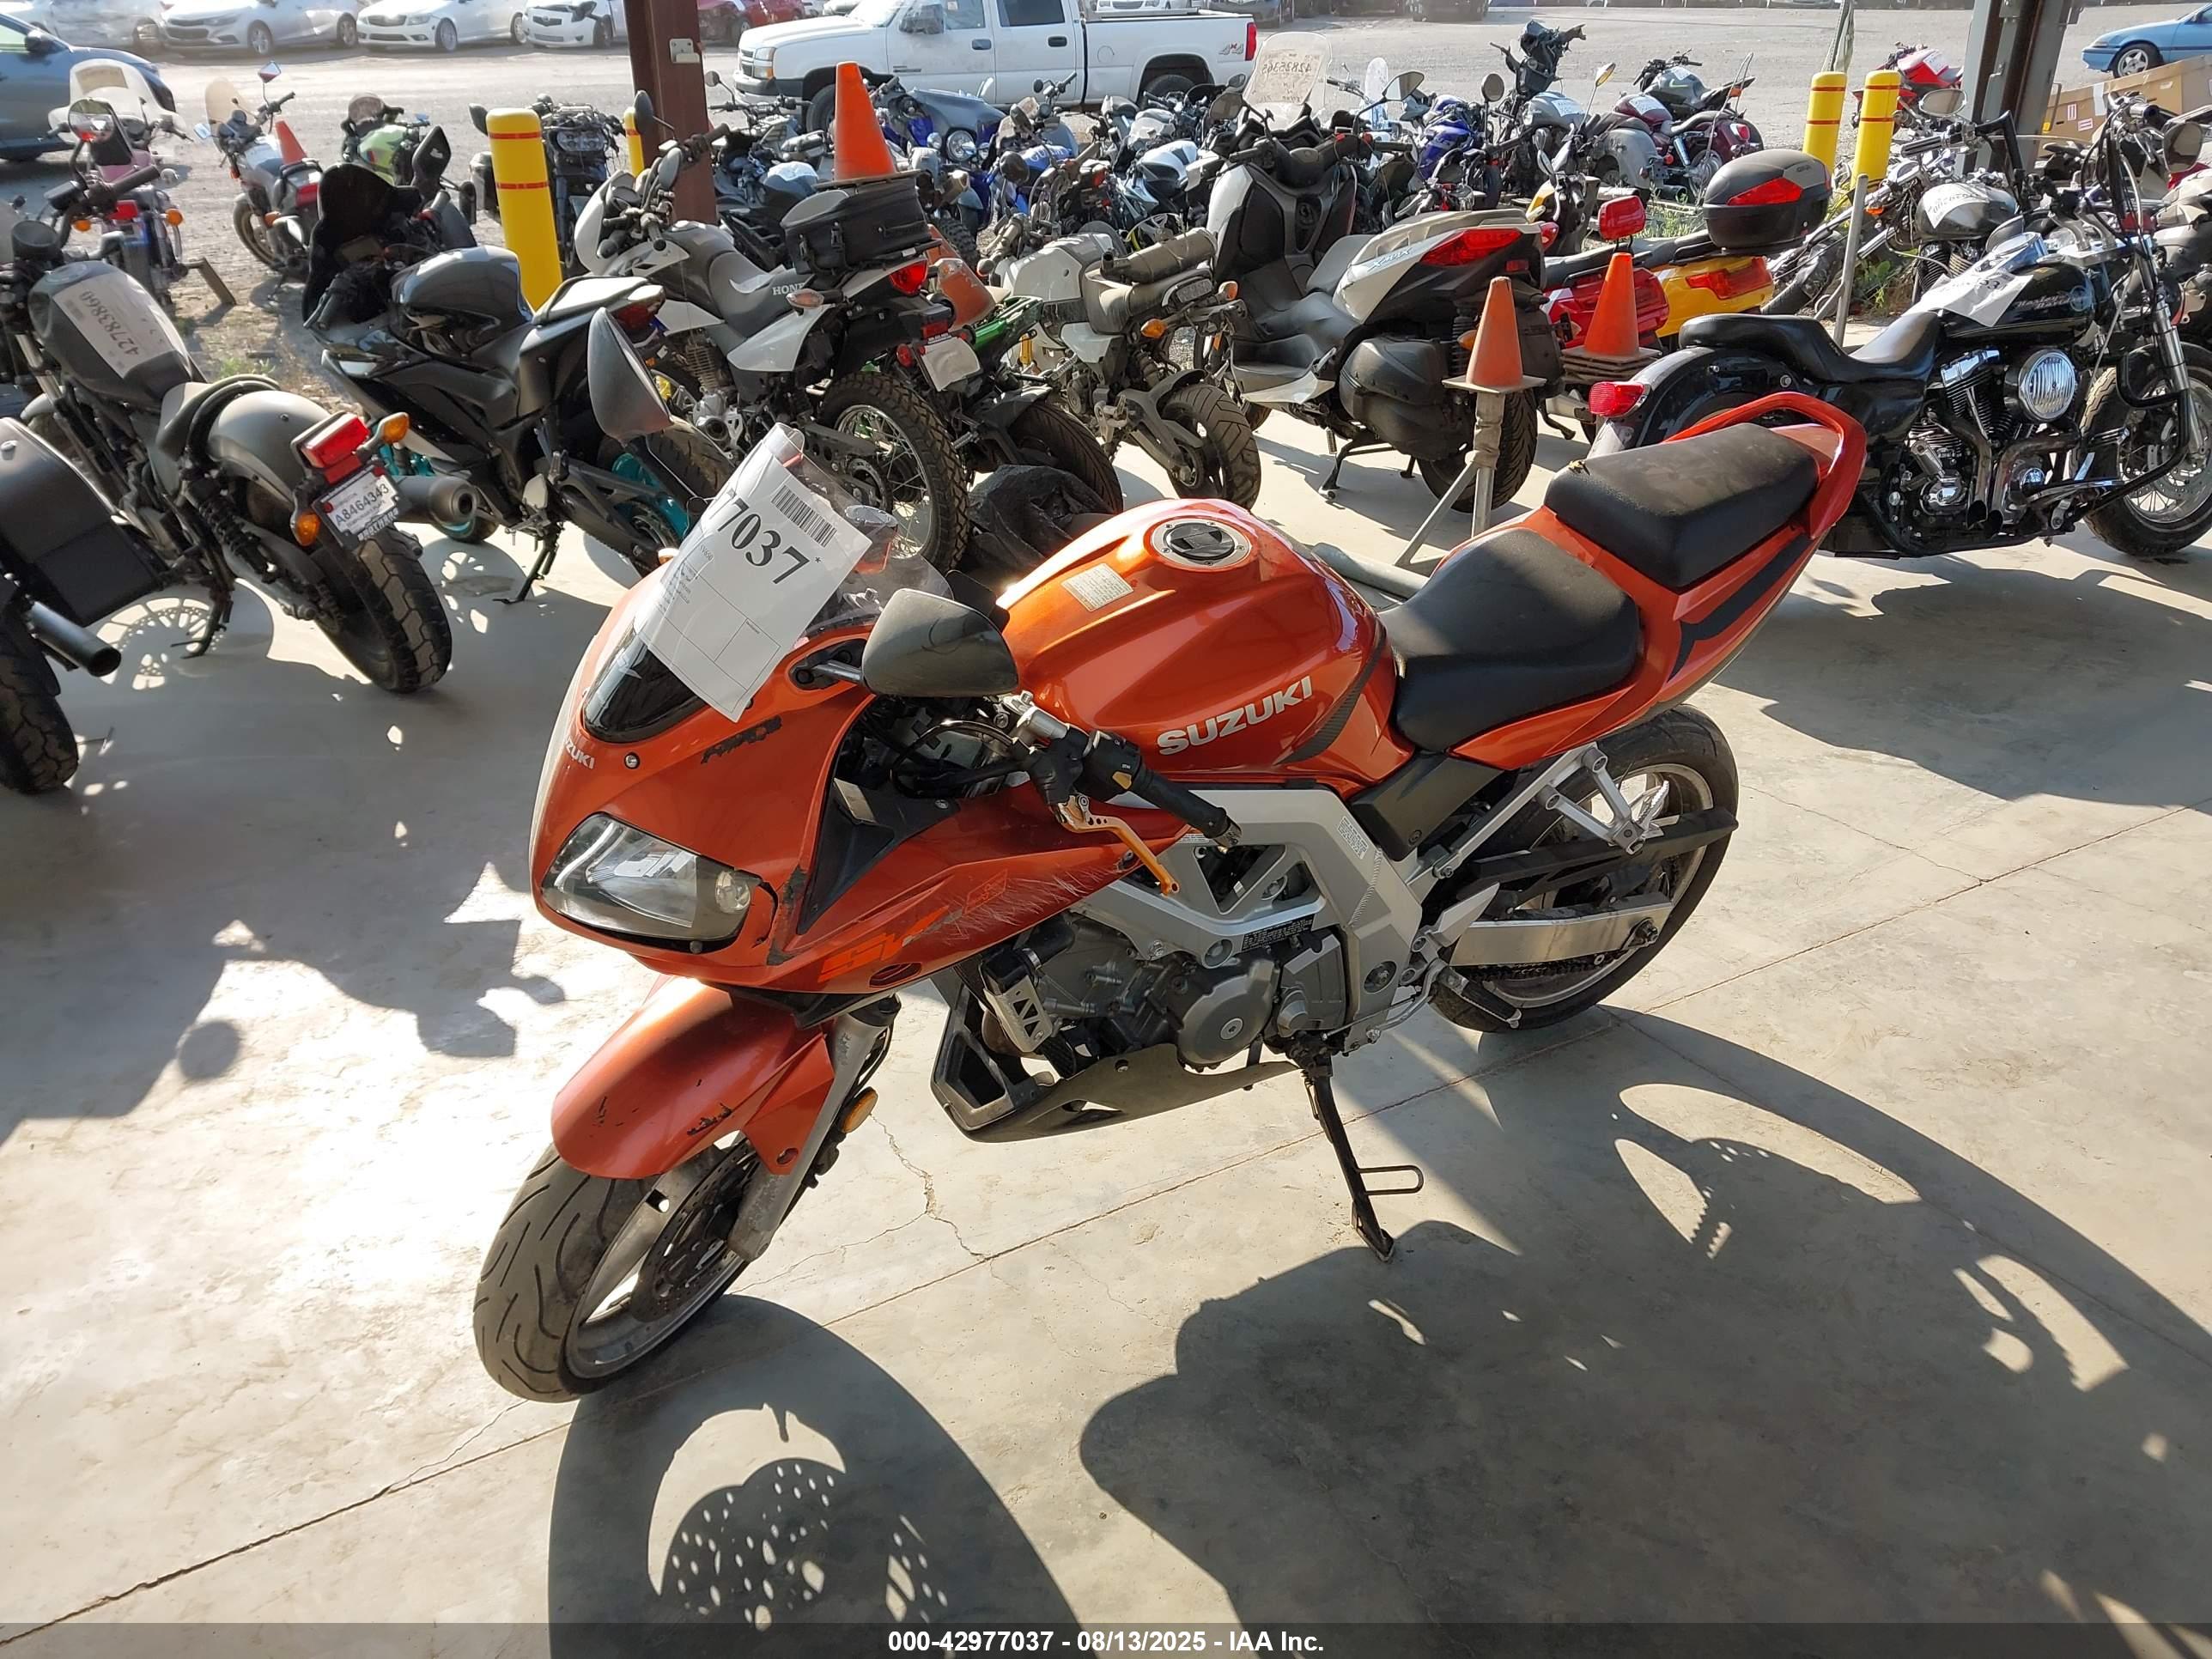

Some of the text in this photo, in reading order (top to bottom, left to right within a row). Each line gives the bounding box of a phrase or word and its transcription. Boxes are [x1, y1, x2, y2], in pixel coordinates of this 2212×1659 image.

[80, 290, 139, 356] 42783860
[335, 483, 390, 525] A8464343
[1157, 675, 1313, 756] SUZUKI
